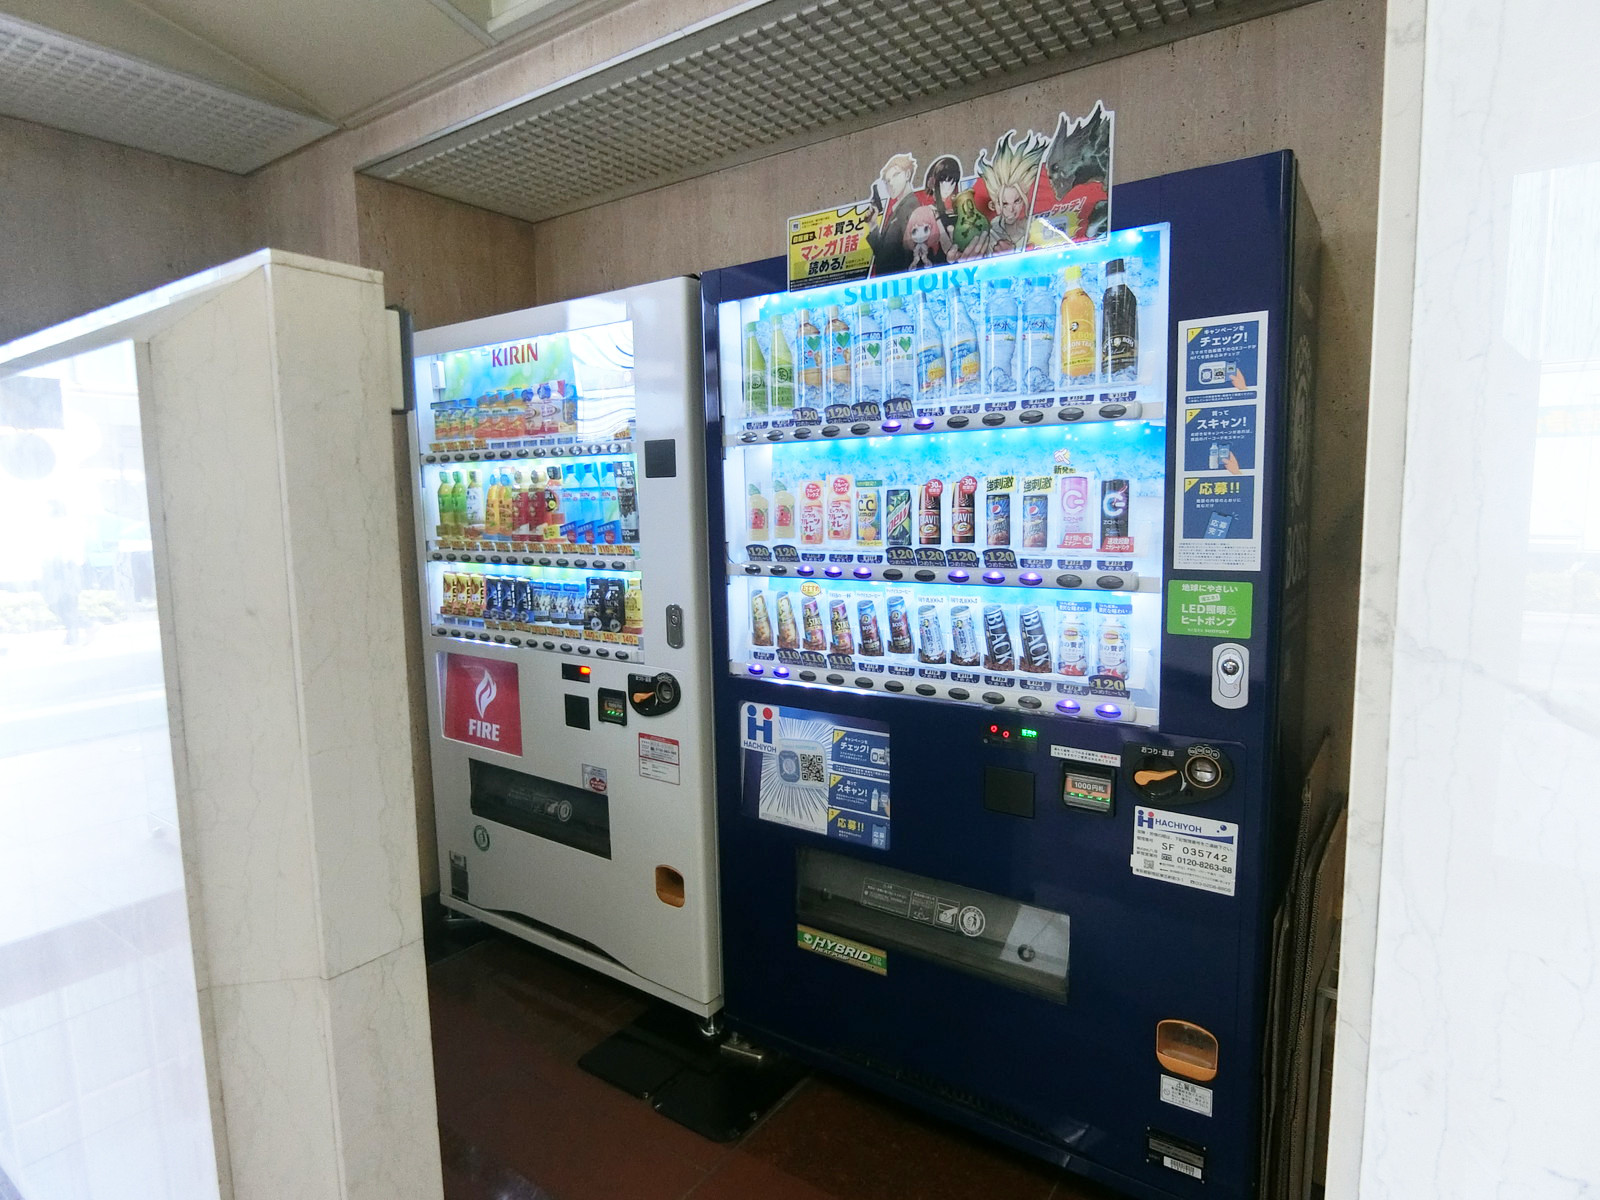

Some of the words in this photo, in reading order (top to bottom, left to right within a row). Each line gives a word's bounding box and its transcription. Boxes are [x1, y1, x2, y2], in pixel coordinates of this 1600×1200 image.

[818, 217, 865, 240] 1本買うと
[801, 233, 859, 262] マンガ1話
[1204, 325, 1244, 335] キャンペーンを
[1200, 332, 1248, 347] チェック!
[491, 342, 538, 368] KIRIN
[1197, 416, 1247, 430] スキャン!
[1199, 481, 1240, 495] 応募!!
[830, 520, 843, 528] オレ
[1210, 519, 1228, 529] 応募
[1208, 527, 1224, 537] 完了
[1181, 583, 1238, 593] 地球にやさしい
[1181, 615, 1238, 627] ヒートポンプ
[987, 609, 1012, 665] BLACK
[1022, 611, 1050, 667] BLACK
[1090, 678, 1124, 690] ¥120
[468, 719, 500, 742] FIRE
[743, 741, 777, 753] HACHIYOH
[840, 741, 869, 753] チェック!
[837, 784, 868, 797] スキャン!
[1074, 781, 1105, 793] 1000円札
[837, 818, 864, 833] 応募!!
[1155, 818, 1202, 833] HACHIYOH
[1161, 842, 1175, 851] SF
[1182, 846, 1228, 862] 035742
[1177, 856, 1232, 874] 0120-8263-88
[812, 936, 871, 962] HYBRID
